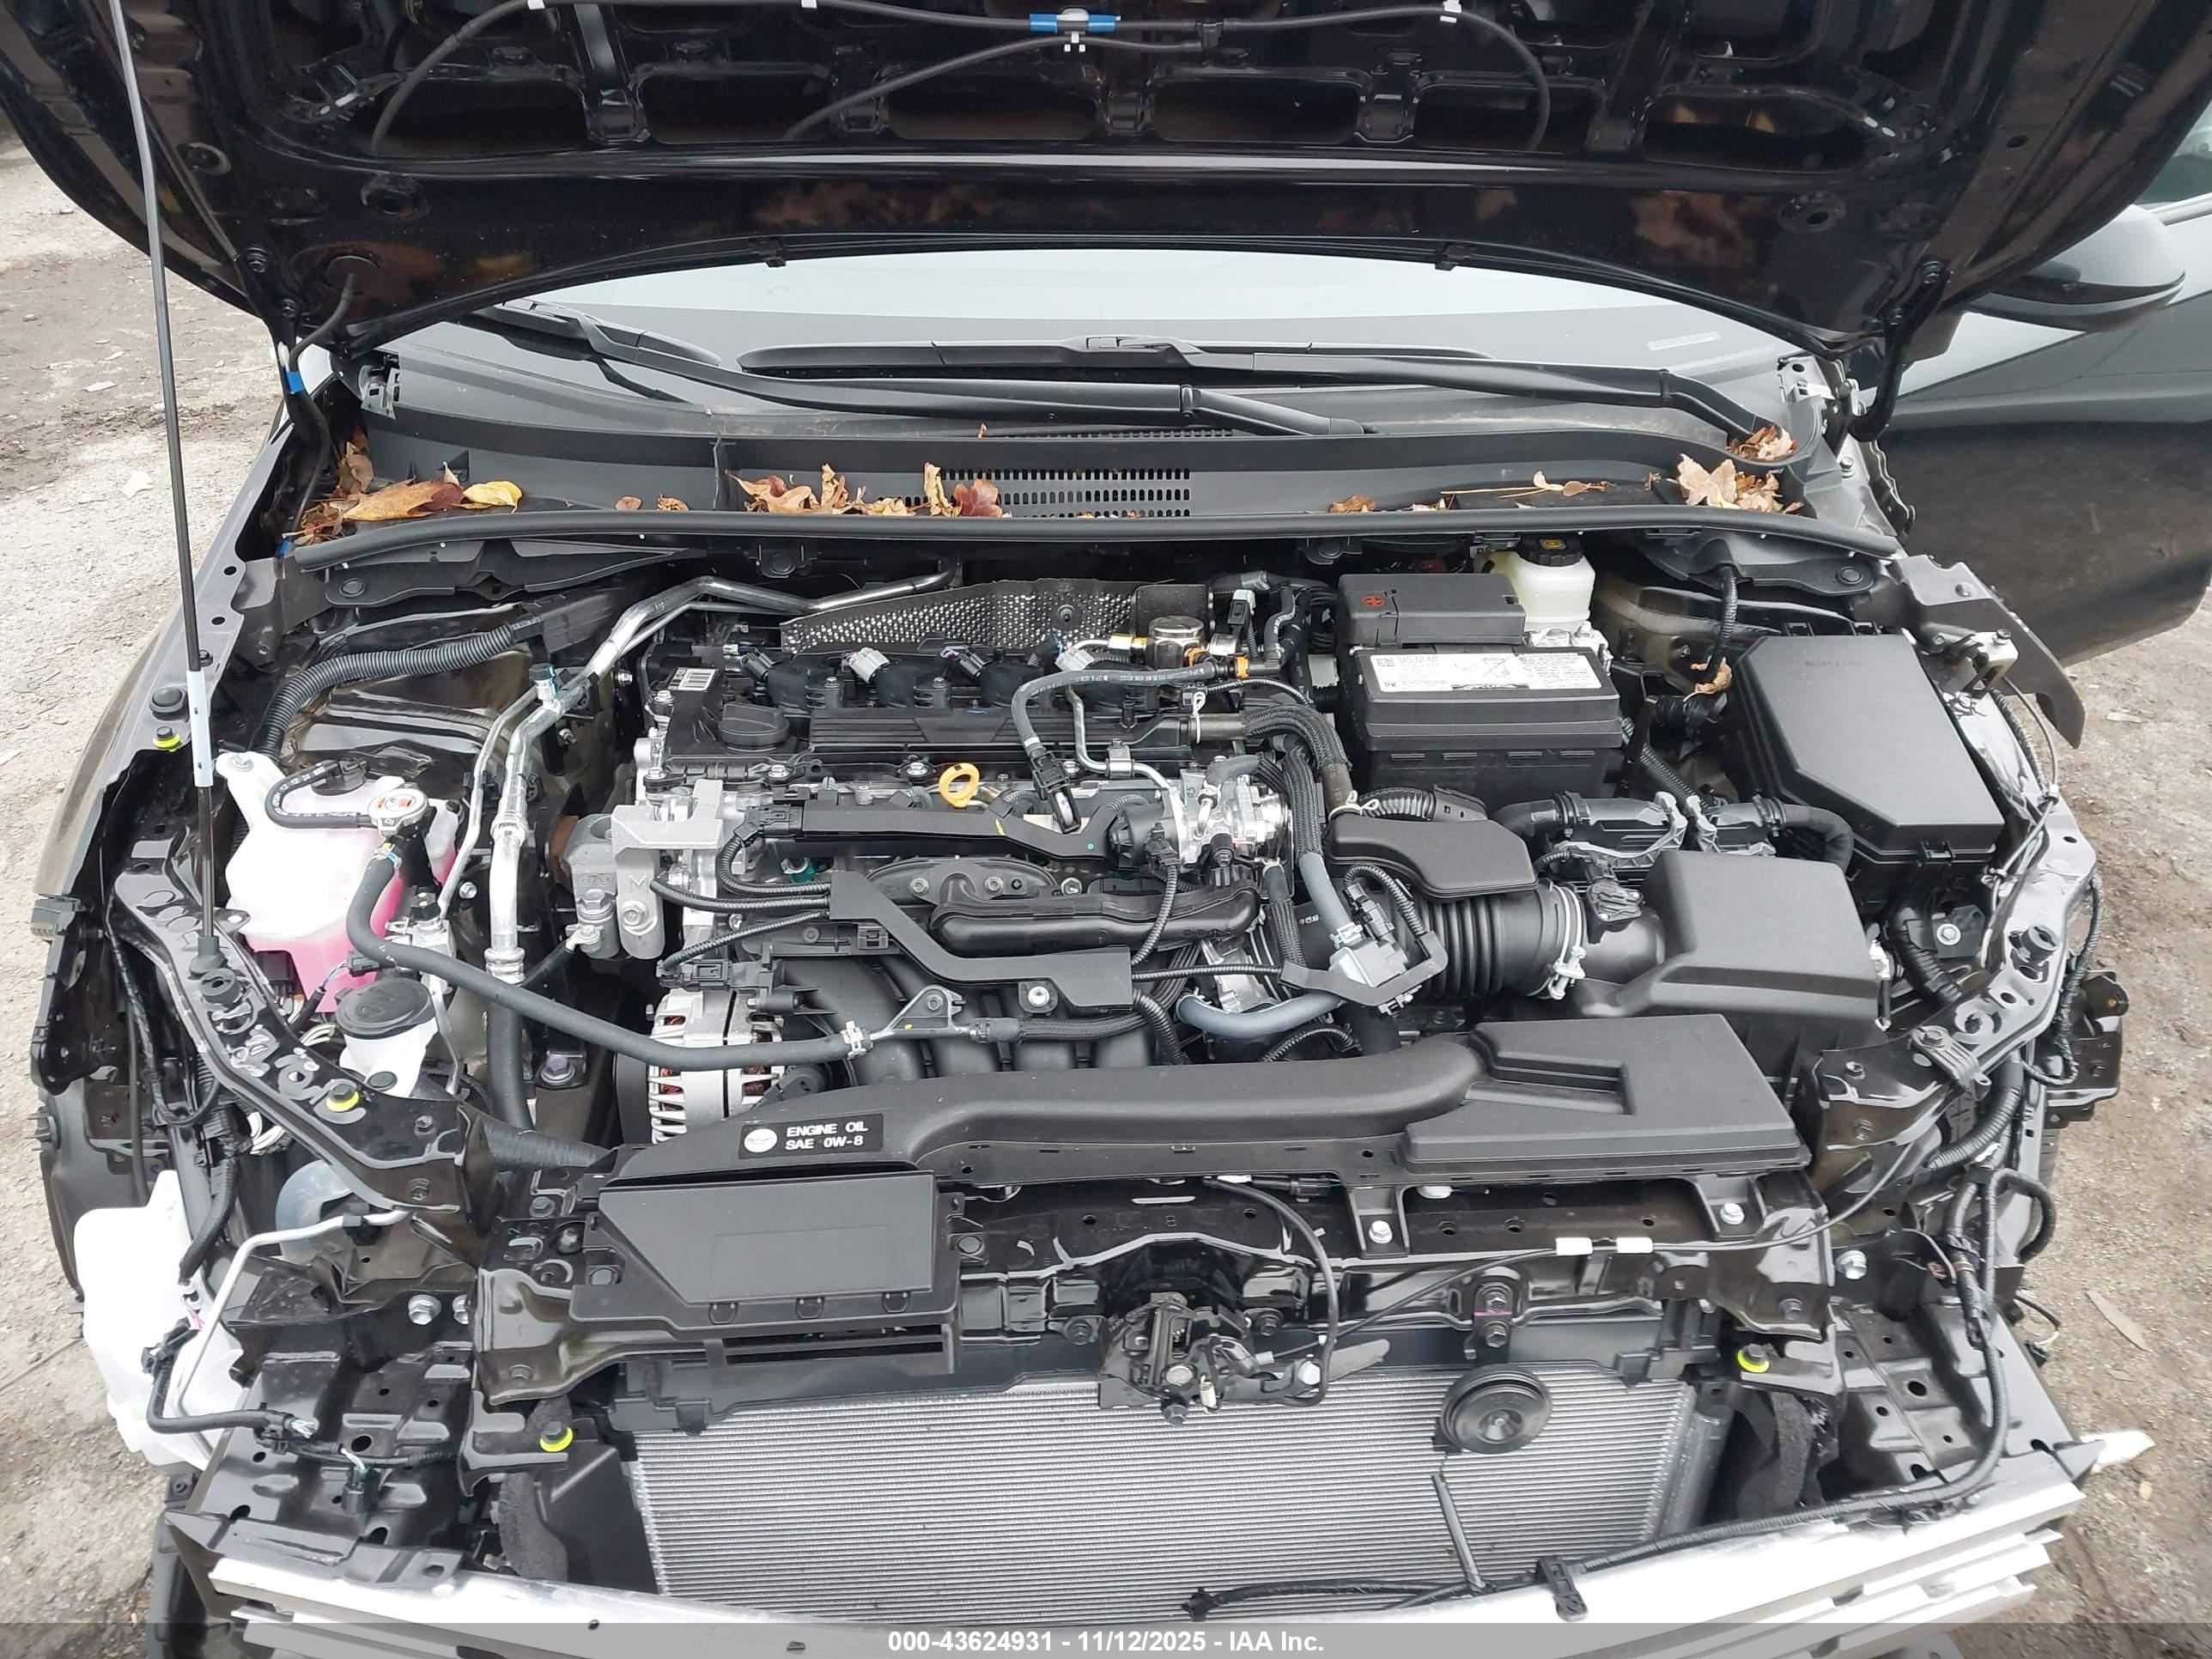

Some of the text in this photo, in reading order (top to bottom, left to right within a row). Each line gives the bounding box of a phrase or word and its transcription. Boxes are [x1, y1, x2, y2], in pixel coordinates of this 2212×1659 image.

[786, 1121, 869, 1138] ENGINE OIL
[785, 1134, 864, 1151] SAE 0W-8
